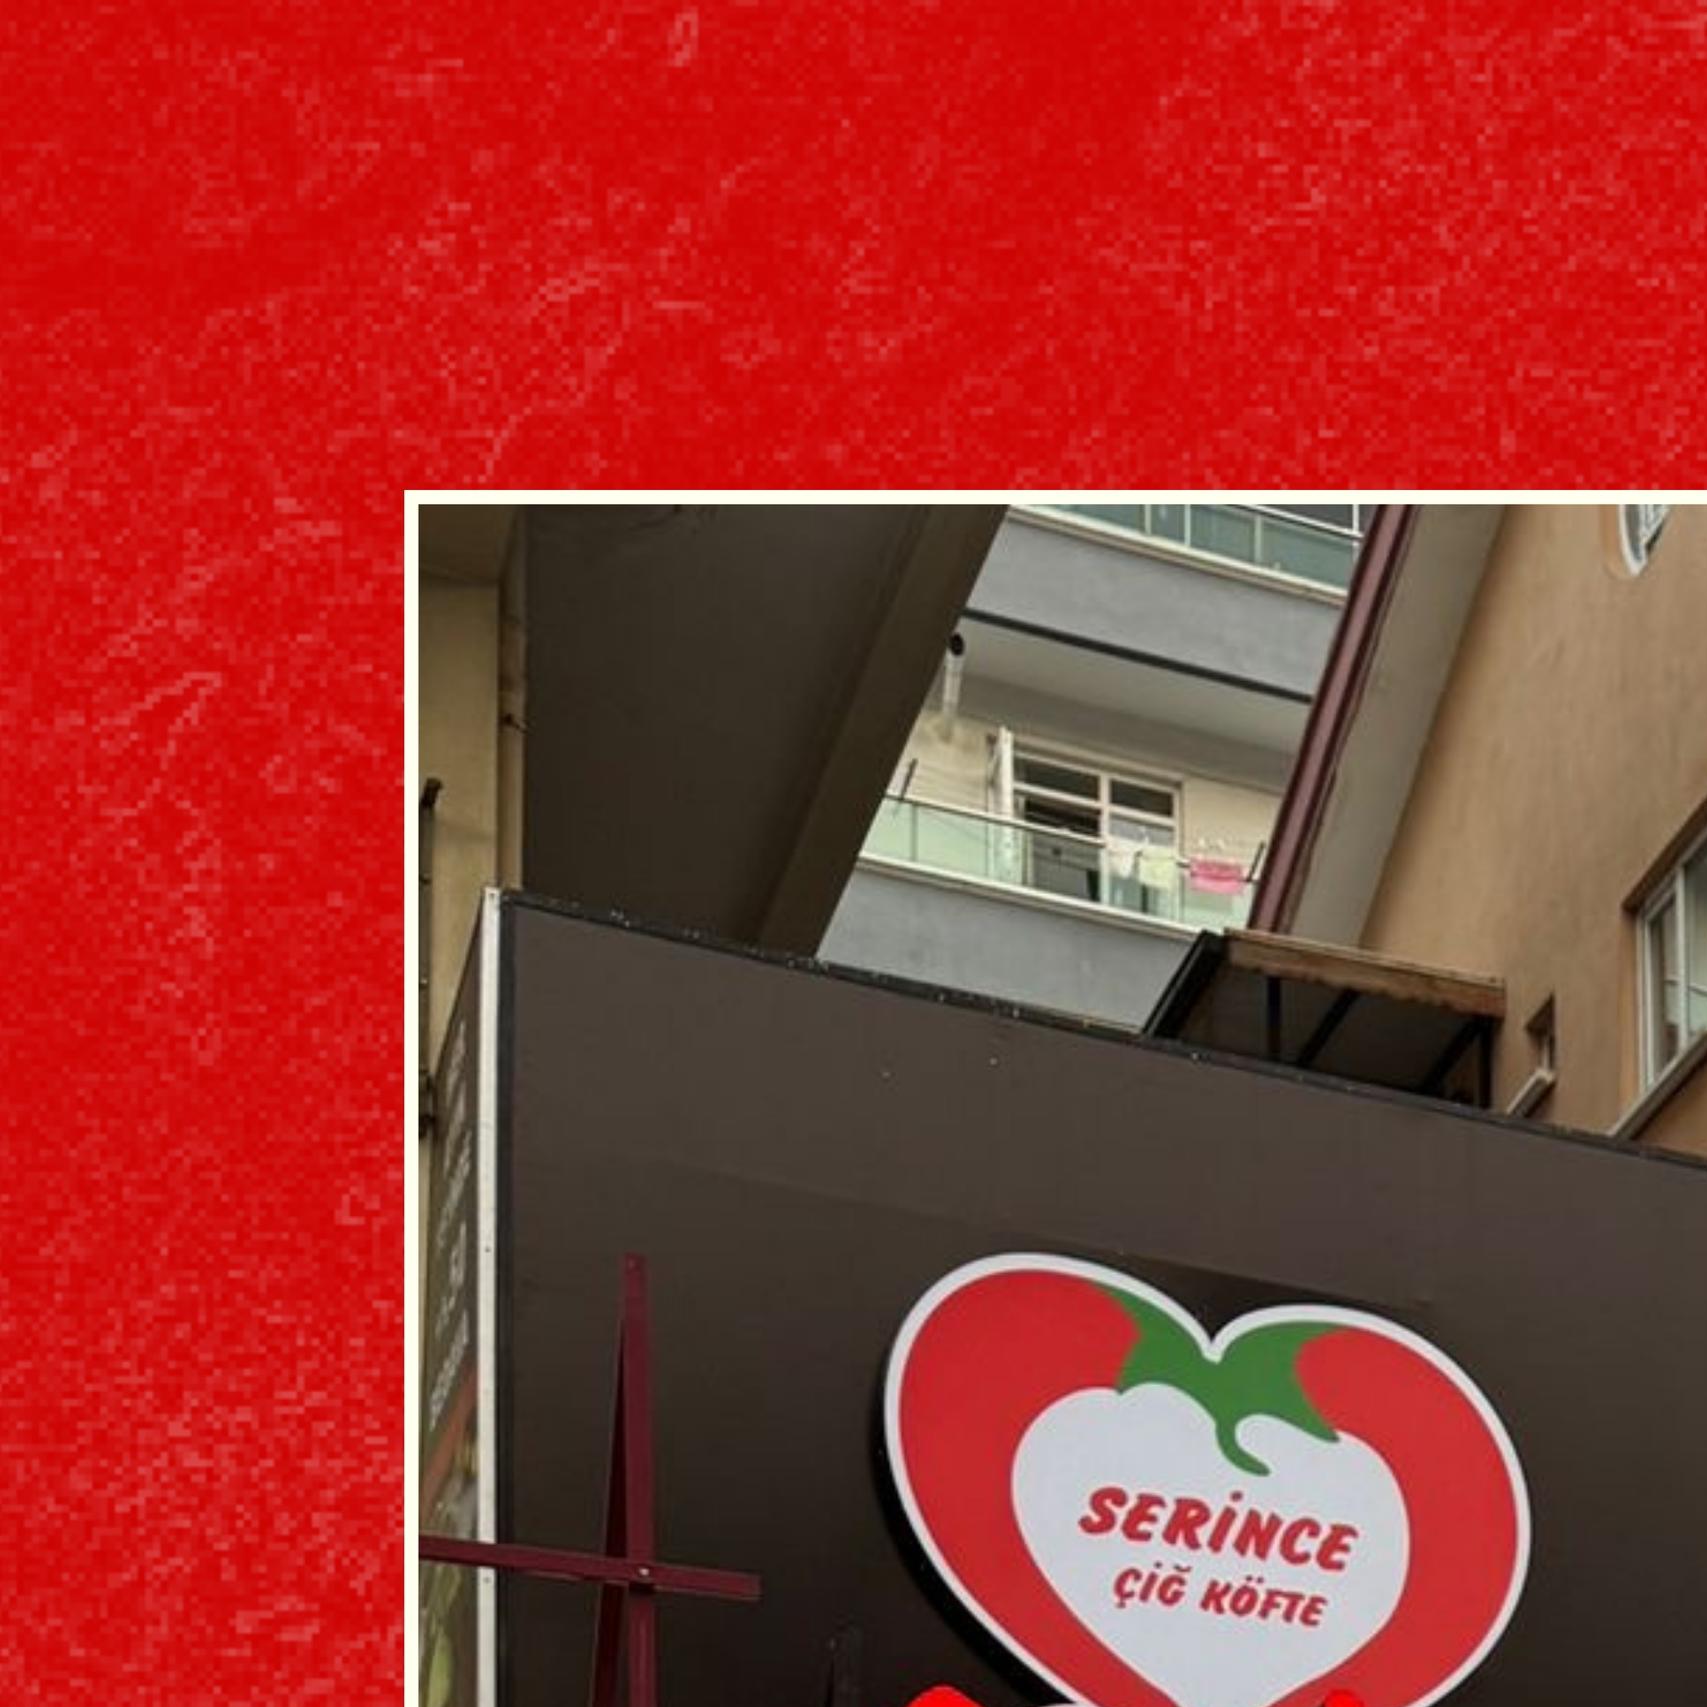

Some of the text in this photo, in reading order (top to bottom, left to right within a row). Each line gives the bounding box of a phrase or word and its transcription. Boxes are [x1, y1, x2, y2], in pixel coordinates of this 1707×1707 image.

[1078, 1485, 1359, 1574] SERİNCE
[1113, 1561, 1328, 1629] ÇİĞ KÖFTE
